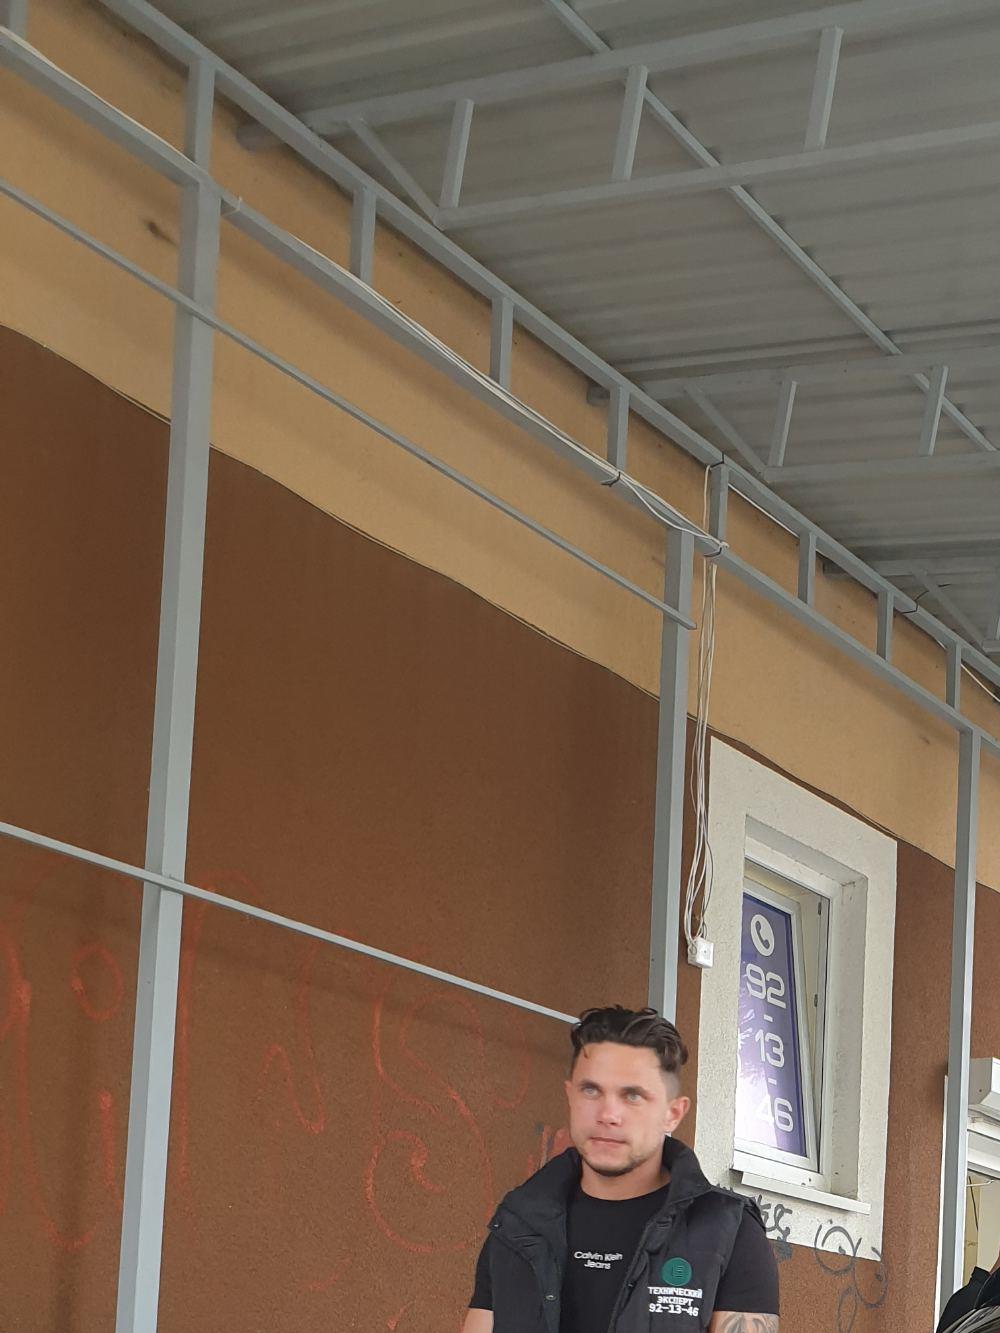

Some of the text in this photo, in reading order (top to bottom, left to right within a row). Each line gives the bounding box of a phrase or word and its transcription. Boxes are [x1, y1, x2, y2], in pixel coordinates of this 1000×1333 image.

[745, 963, 787, 1009] 92
[754, 1029, 785, 1068] 13
[573, 1251, 623, 1262] Calvin Klein
[583, 1260, 611, 1270] Jeans
[647, 1286, 703, 1299] ТЕХНИЧЕСКИЙ
[656, 1296, 694, 1307] ЭКСПЕРТ
[648, 1303, 700, 1317] 92-13-46
